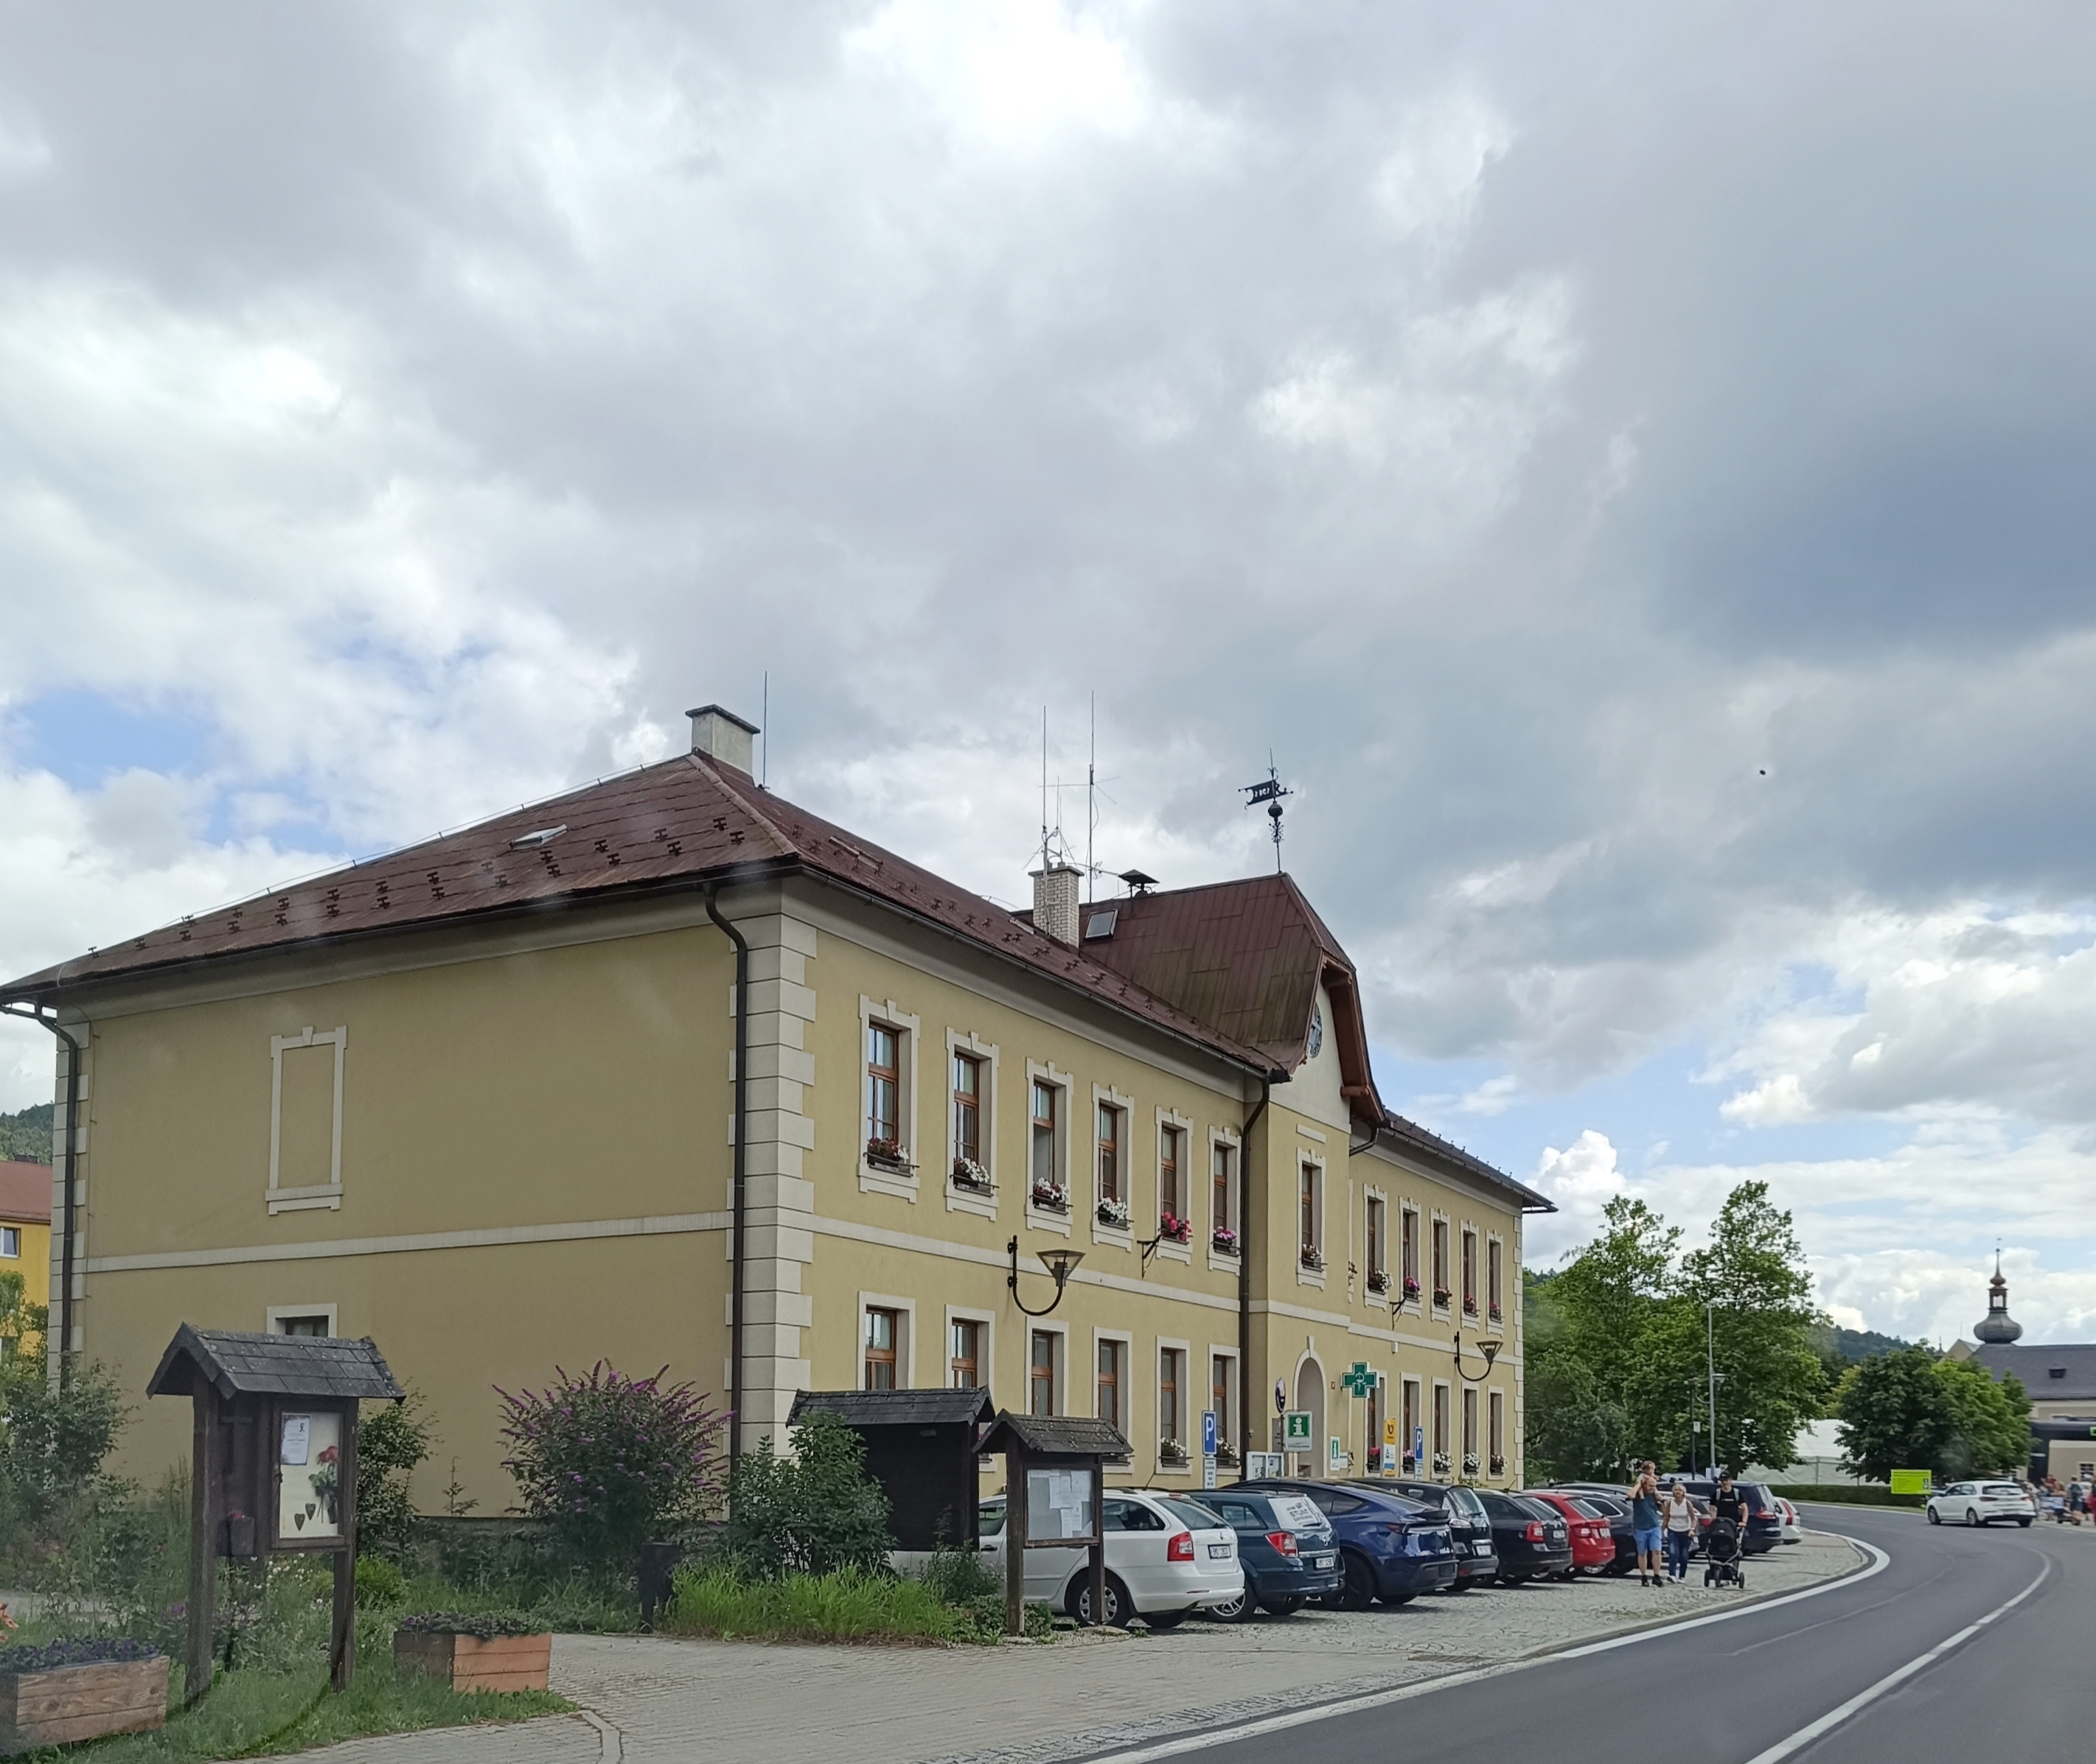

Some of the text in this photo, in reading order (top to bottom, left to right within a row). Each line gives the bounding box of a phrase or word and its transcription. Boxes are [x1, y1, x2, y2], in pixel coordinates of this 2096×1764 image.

[1205, 1416, 1214, 1441] P
[1293, 1418, 1304, 1435] i
[1416, 1431, 1422, 1450] P
